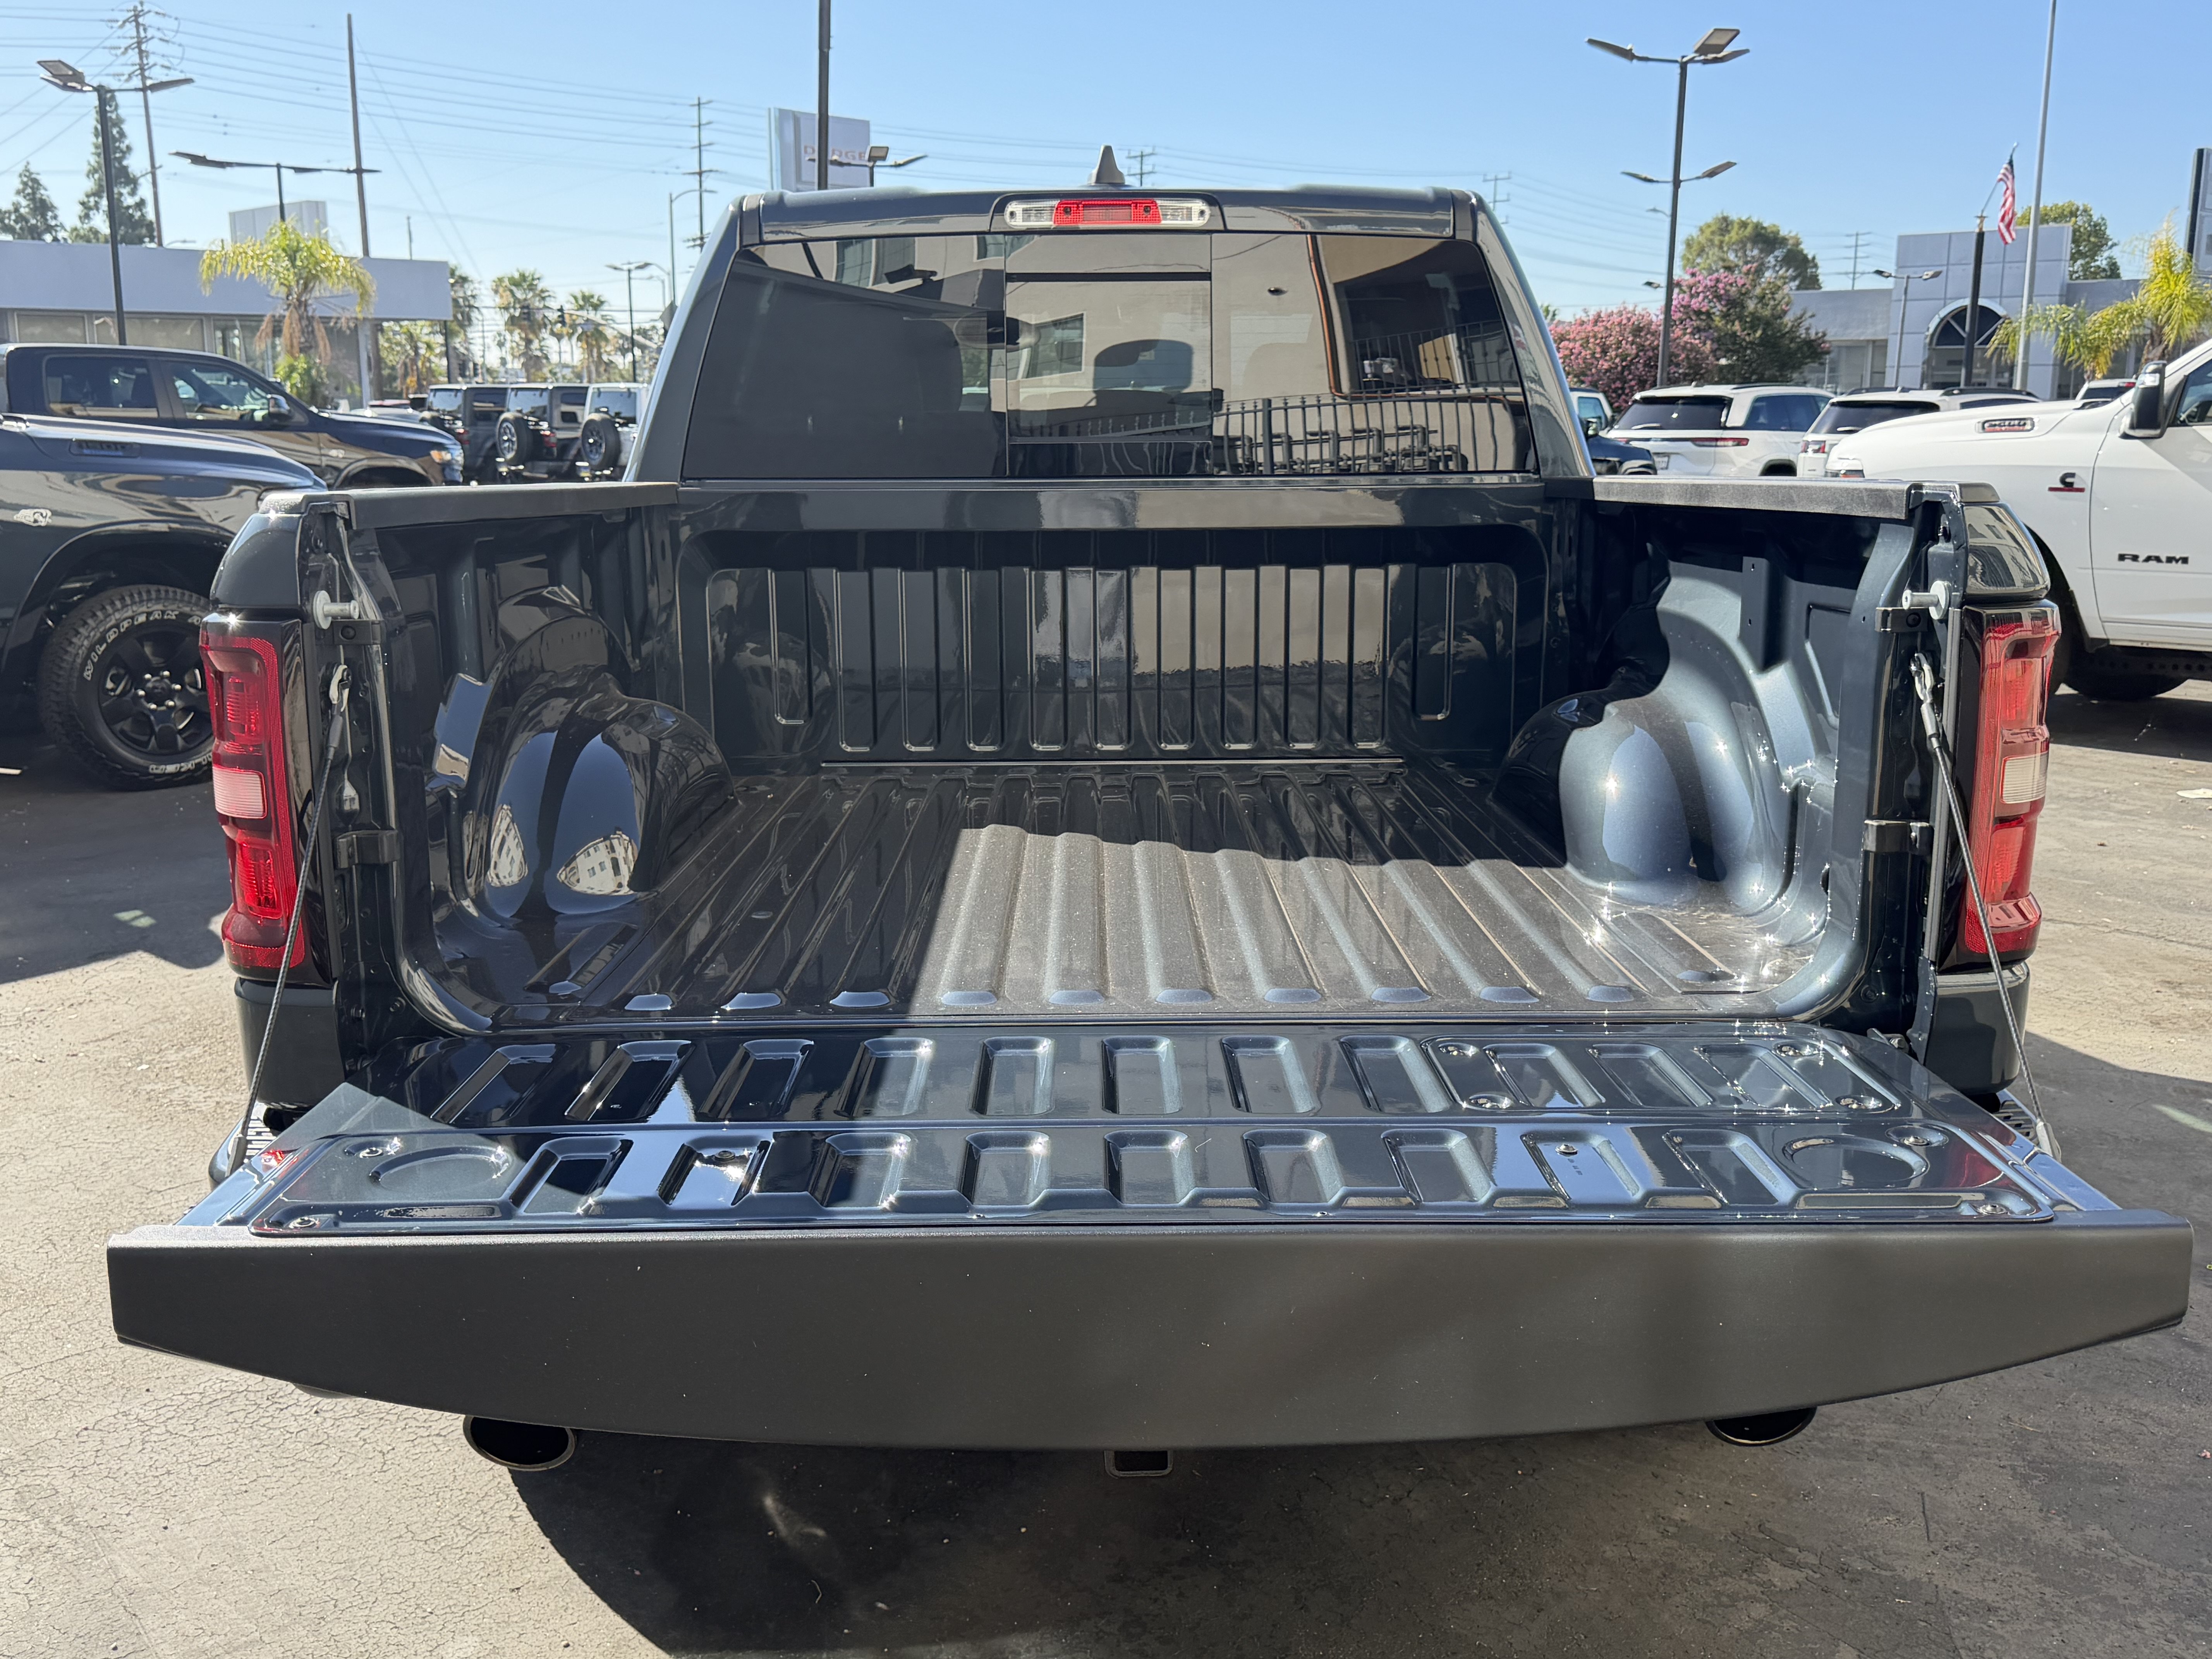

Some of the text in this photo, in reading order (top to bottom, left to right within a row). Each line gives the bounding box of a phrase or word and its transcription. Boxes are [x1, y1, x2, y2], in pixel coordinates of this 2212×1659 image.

[804, 145, 866, 161] DDGE
[2118, 553, 2189, 564] RAM
[83, 610, 179, 681] WILDPEAK
[149, 752, 212, 773] LKEN
